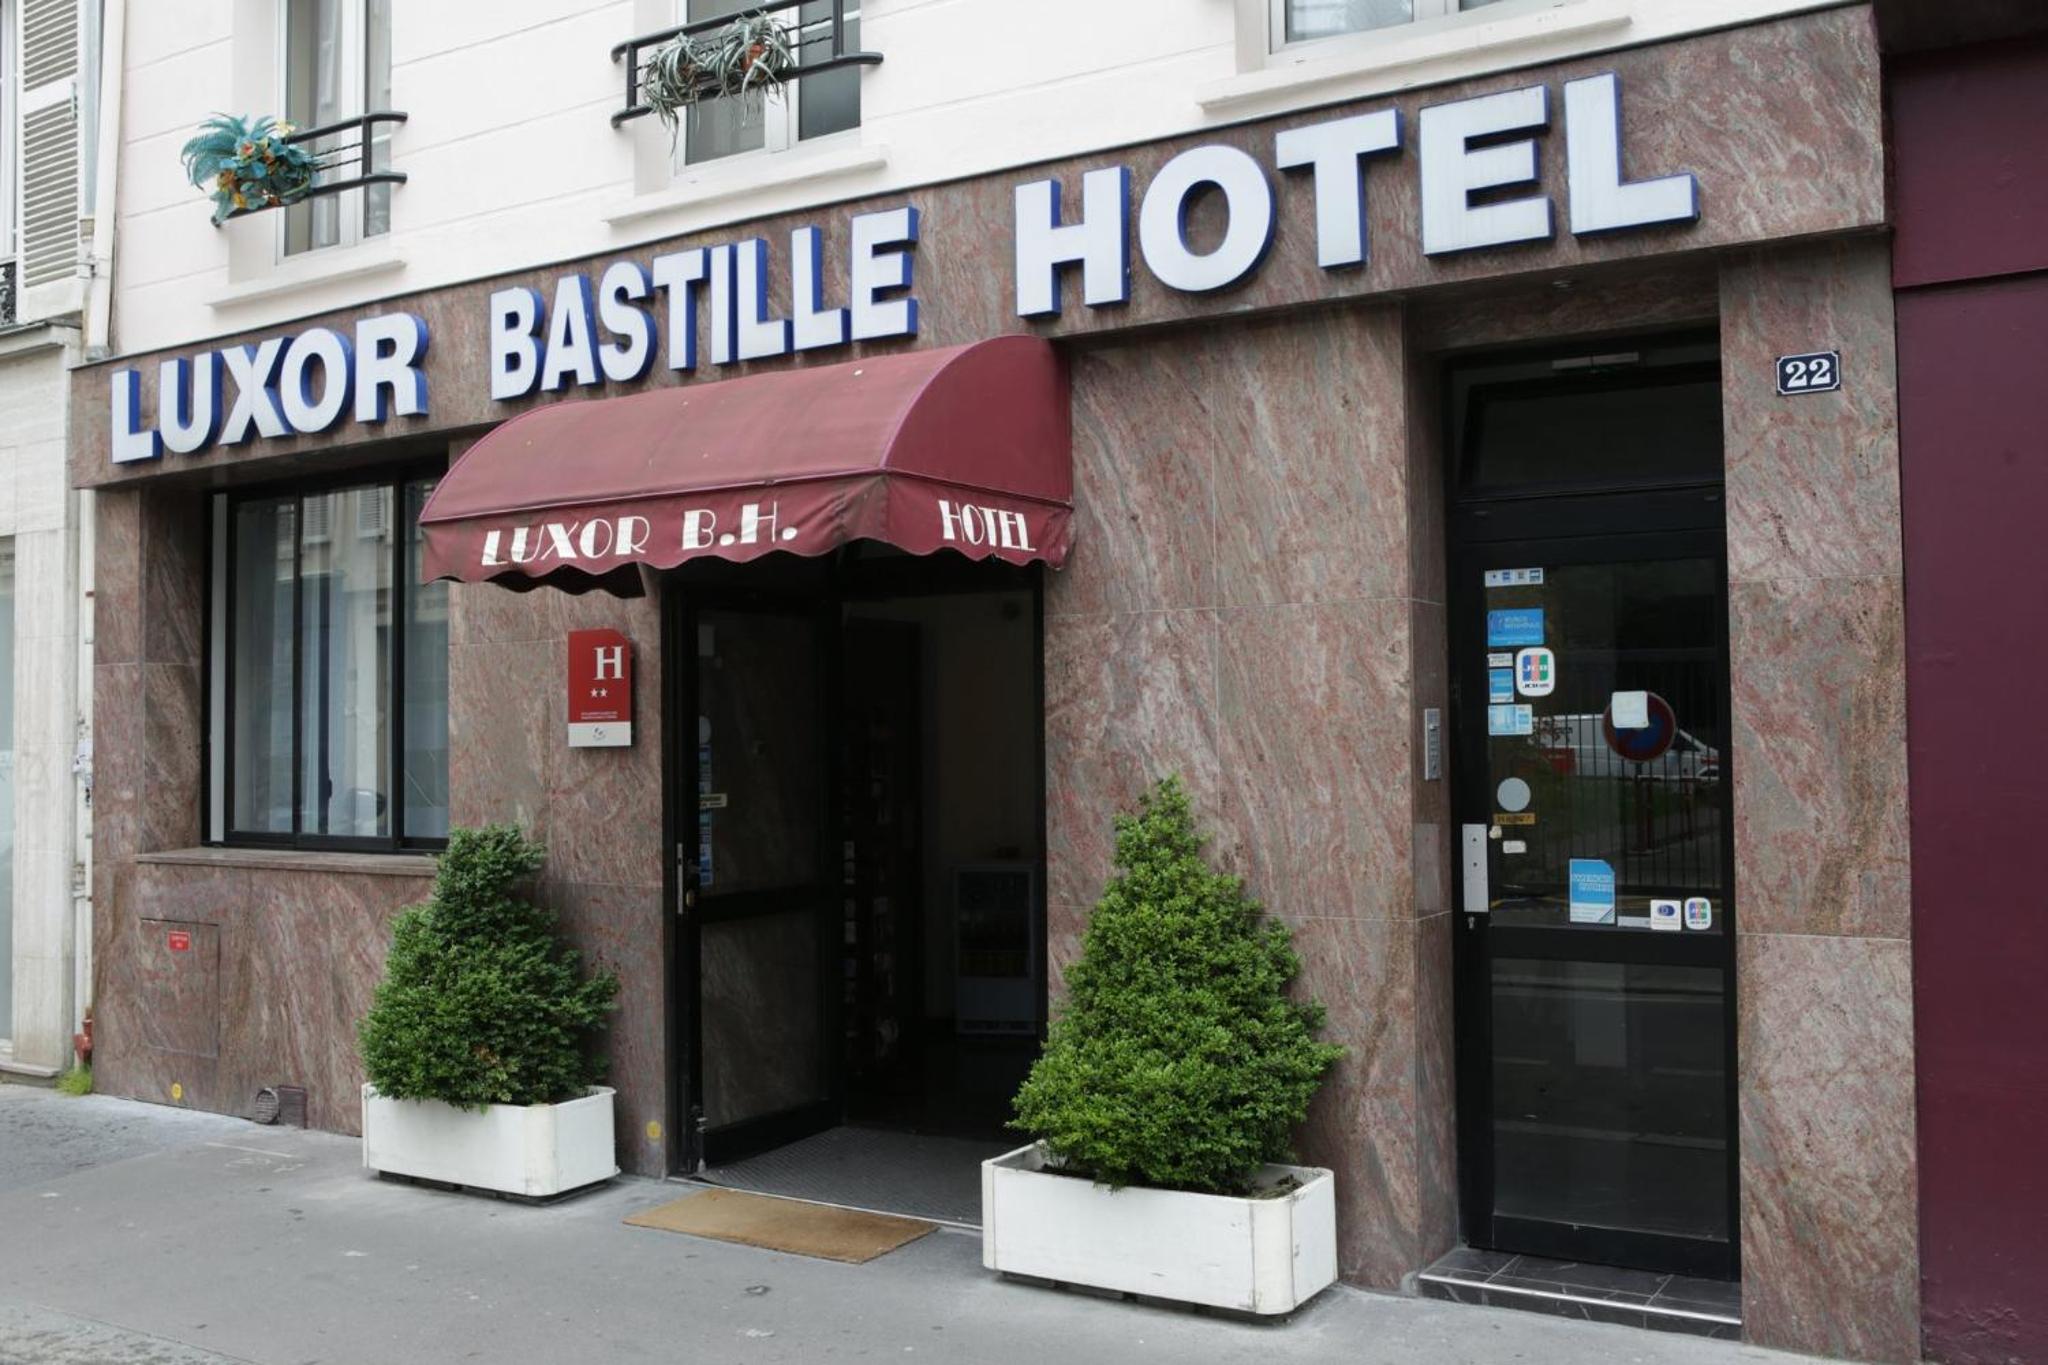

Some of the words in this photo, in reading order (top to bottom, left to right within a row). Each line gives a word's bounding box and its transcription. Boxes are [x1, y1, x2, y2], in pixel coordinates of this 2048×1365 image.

[110, 313, 429, 464] LUXOR
[489, 207, 919, 401] BASTILLE
[1014, 72, 1699, 318] HOTEL
[1785, 358, 1831, 388] 22
[481, 515, 650, 566] LUXOR
[682, 501, 798, 550] B.H.
[938, 500, 1037, 552] HOTEL
[594, 646, 624, 680] H
